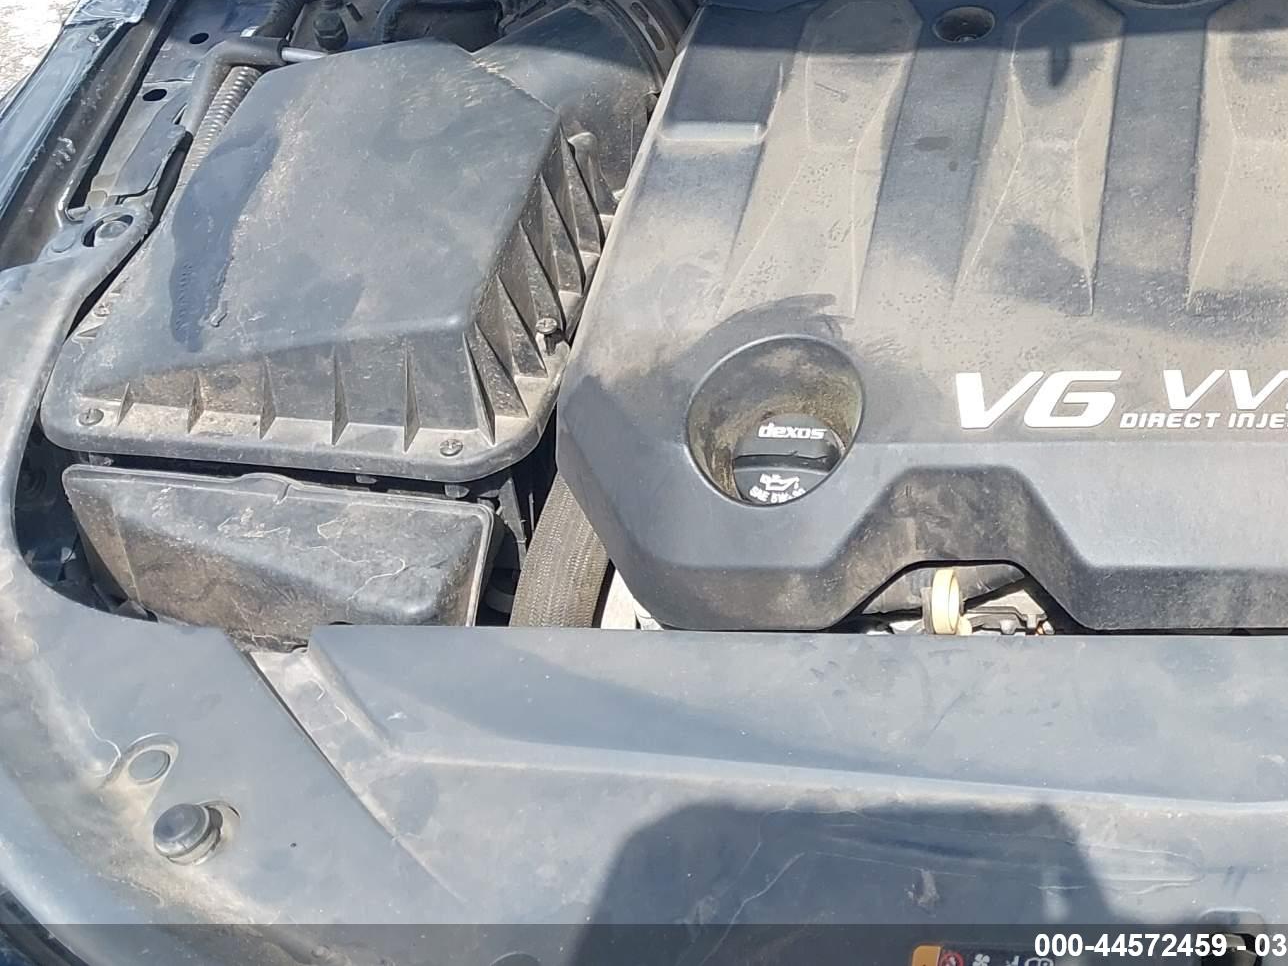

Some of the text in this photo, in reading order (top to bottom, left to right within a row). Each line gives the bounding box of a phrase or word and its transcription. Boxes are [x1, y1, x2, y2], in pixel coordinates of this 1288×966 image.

[954, 369, 1122, 429] V6
[1119, 411, 1221, 429] DIRECT
[758, 422, 828, 439] dexos
[749, 486, 770, 502] SAE
